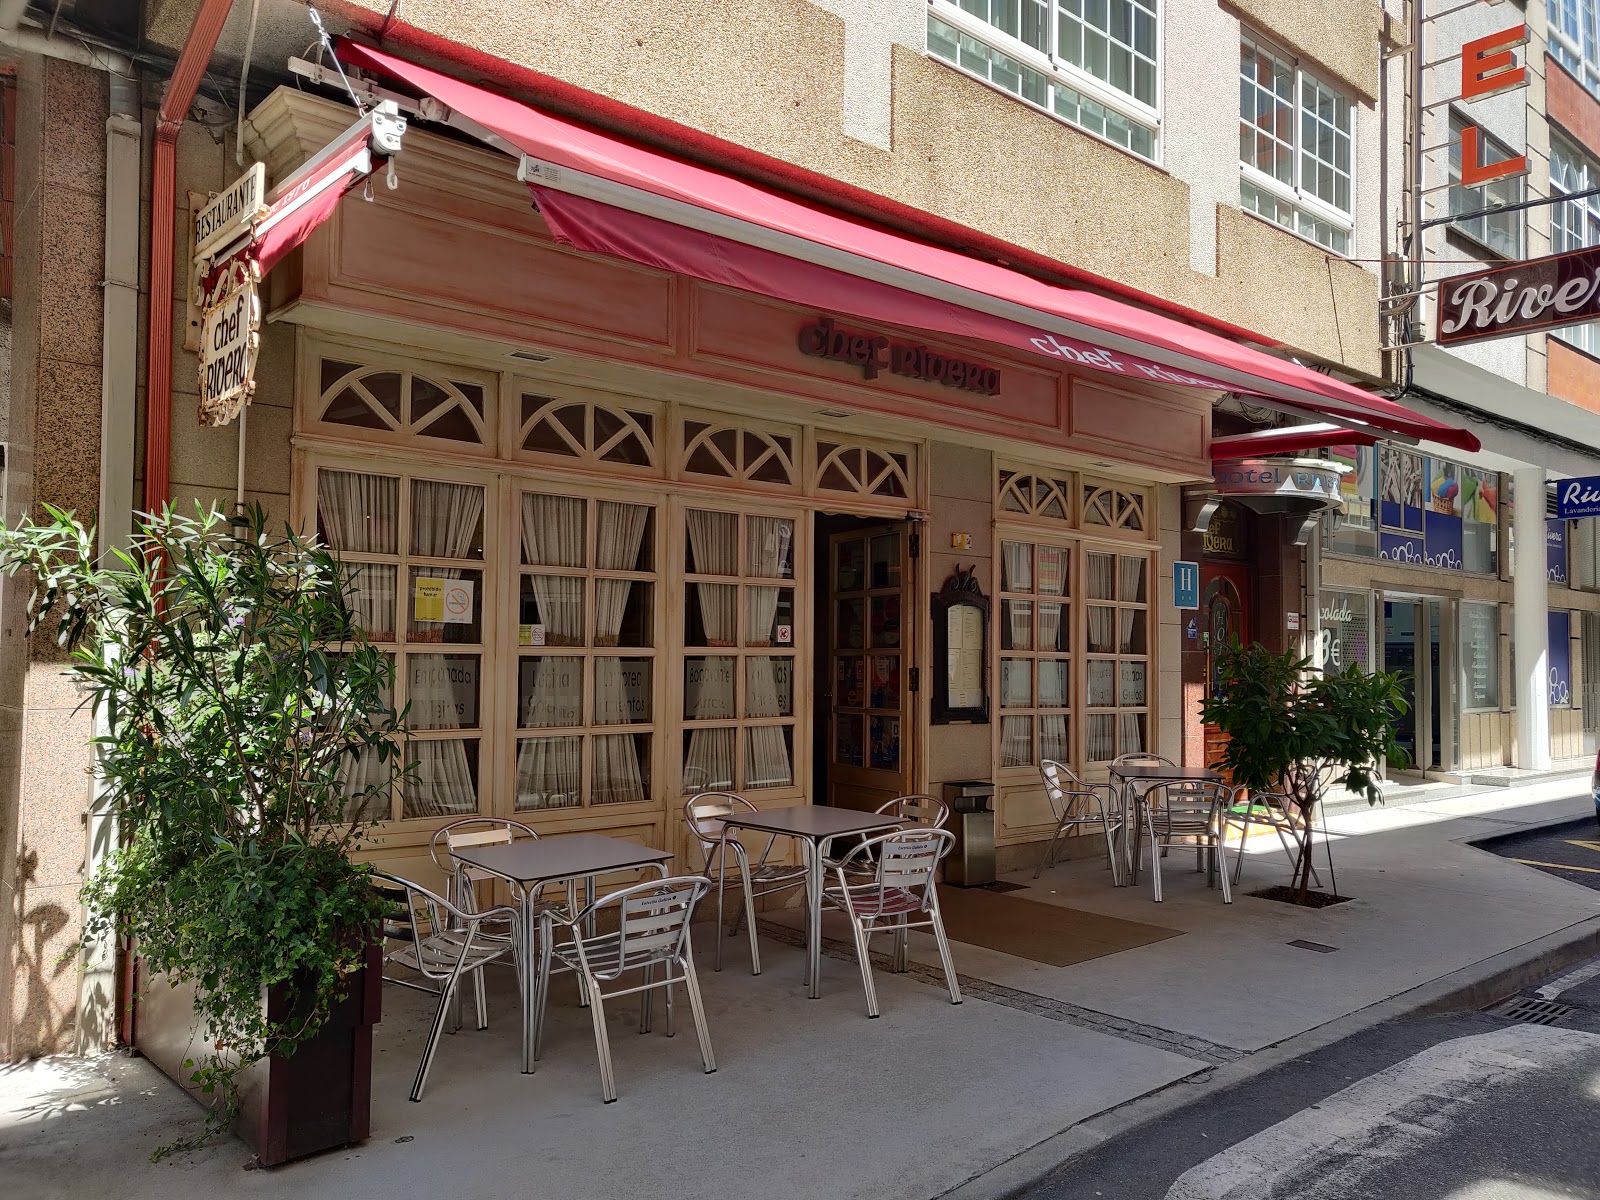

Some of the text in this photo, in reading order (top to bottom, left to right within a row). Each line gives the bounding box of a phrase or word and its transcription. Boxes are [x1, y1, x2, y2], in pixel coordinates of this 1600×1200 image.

[195, 173, 257, 245] RESTAURANTE
[213, 294, 245, 352] chef
[1441, 266, 1600, 334] Rive
[1546, 527, 1562, 542] ivera
[1180, 567, 1192, 592] H
